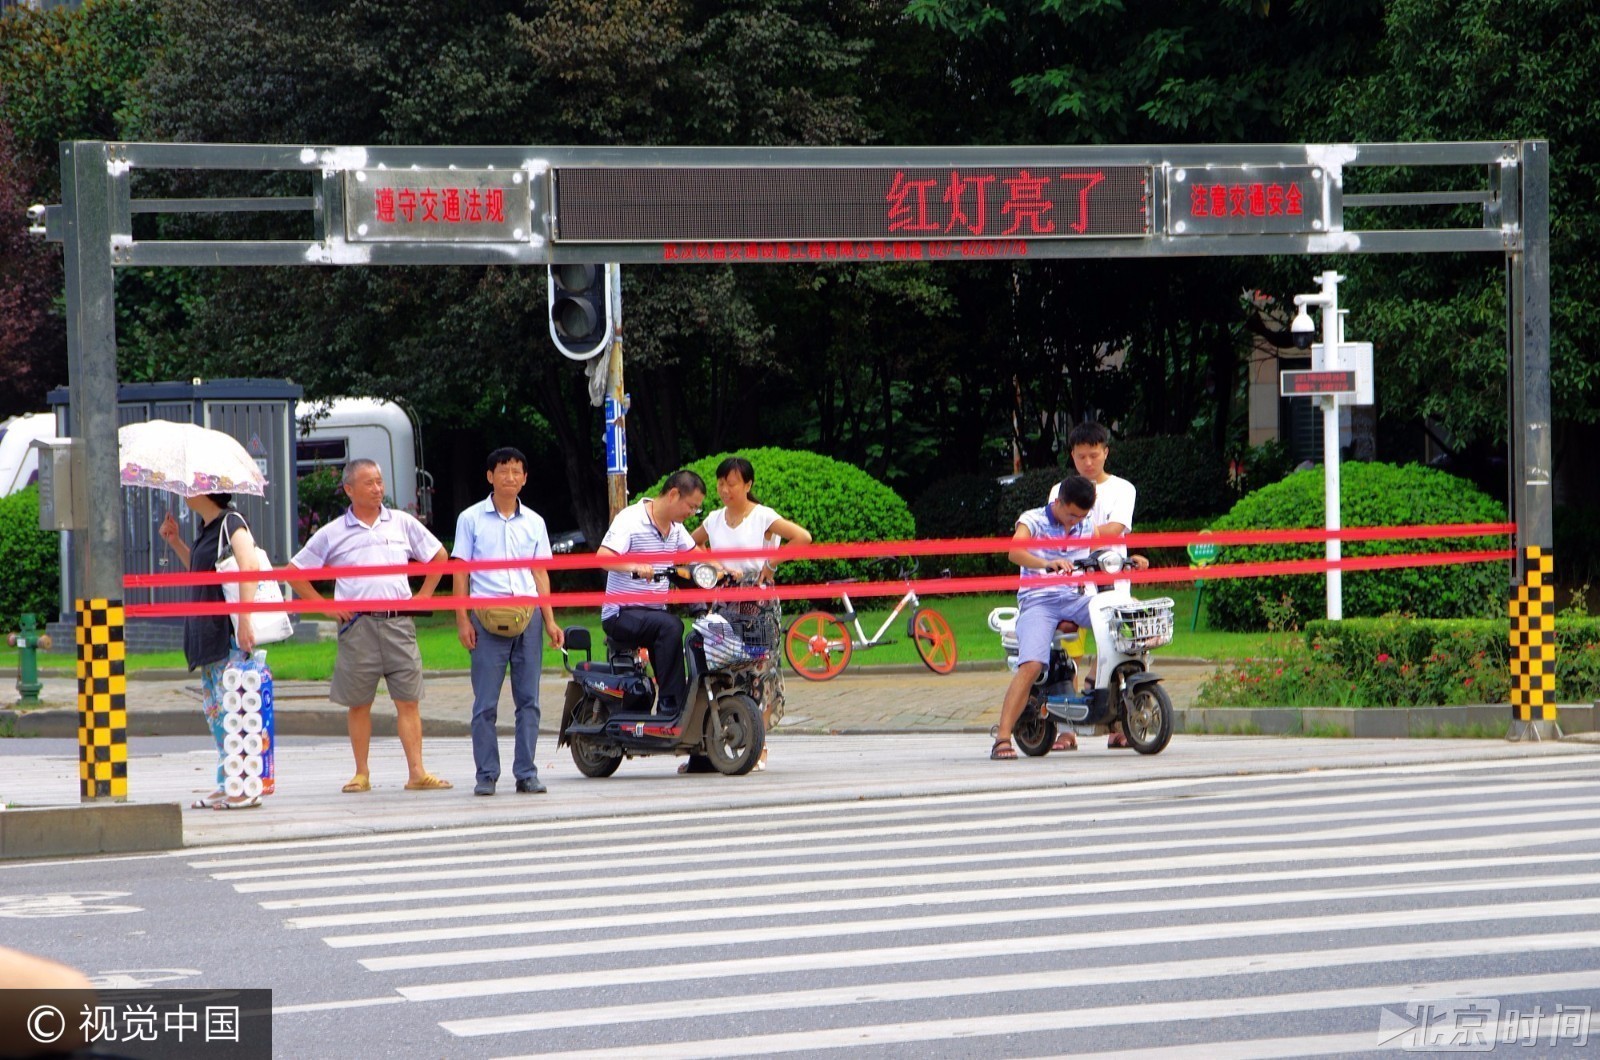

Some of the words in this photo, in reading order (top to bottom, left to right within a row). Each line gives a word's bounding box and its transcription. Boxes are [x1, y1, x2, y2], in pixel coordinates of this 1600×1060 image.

[375, 187, 504, 222] 遵守交通法规
[886, 170, 1106, 236] 红灯亮了
[1190, 181, 1303, 218] 注意交通安全
